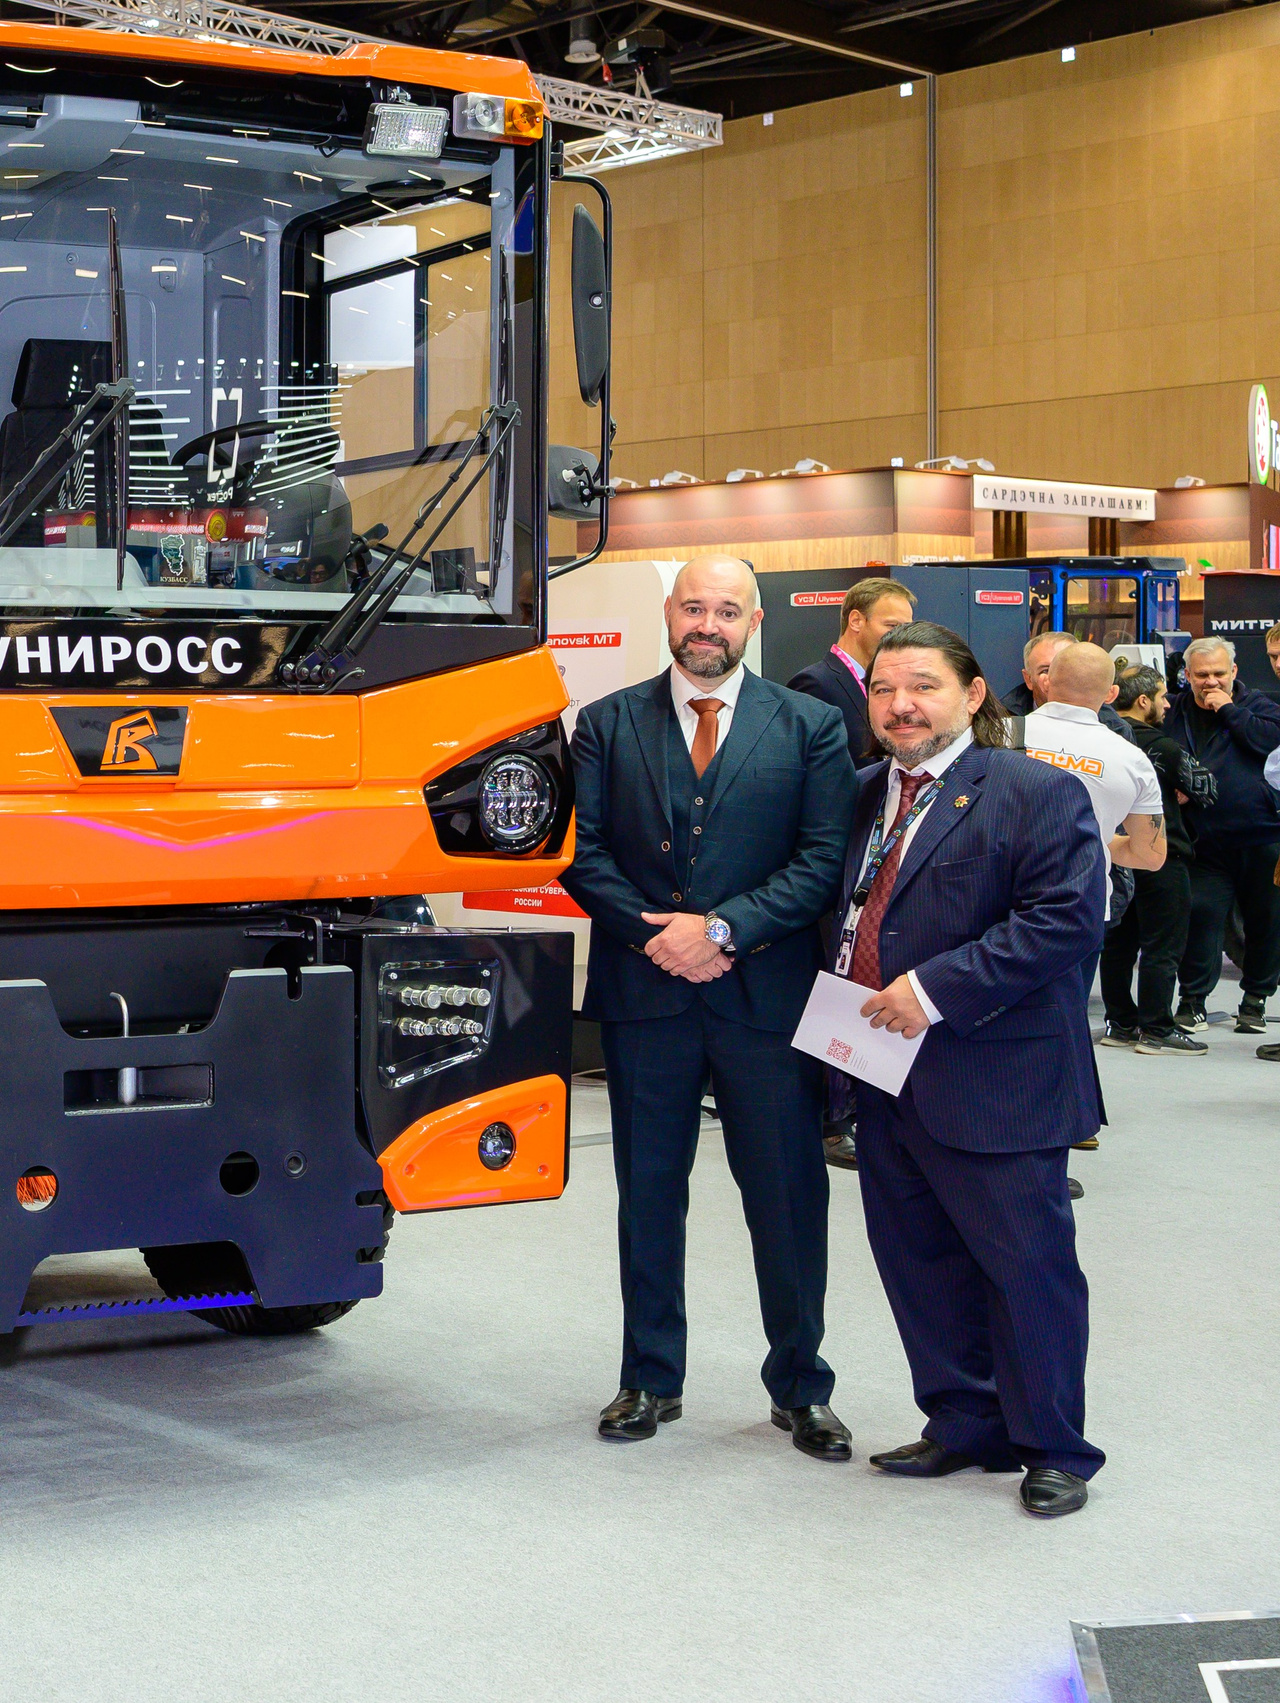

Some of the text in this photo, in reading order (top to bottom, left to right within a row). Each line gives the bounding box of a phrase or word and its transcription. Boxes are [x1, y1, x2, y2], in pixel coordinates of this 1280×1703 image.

[982, 487, 1148, 511] САРДЭЧНА ЗАПРАШАЕМ!
[160, 575, 189, 583] КУЗБАСС
[1210, 619, 1280, 630] МИТР
[593, 634, 616, 645] MT
[539, 886, 569, 896] СУВЕРЕ
[514, 897, 543, 907] РОССИИ
